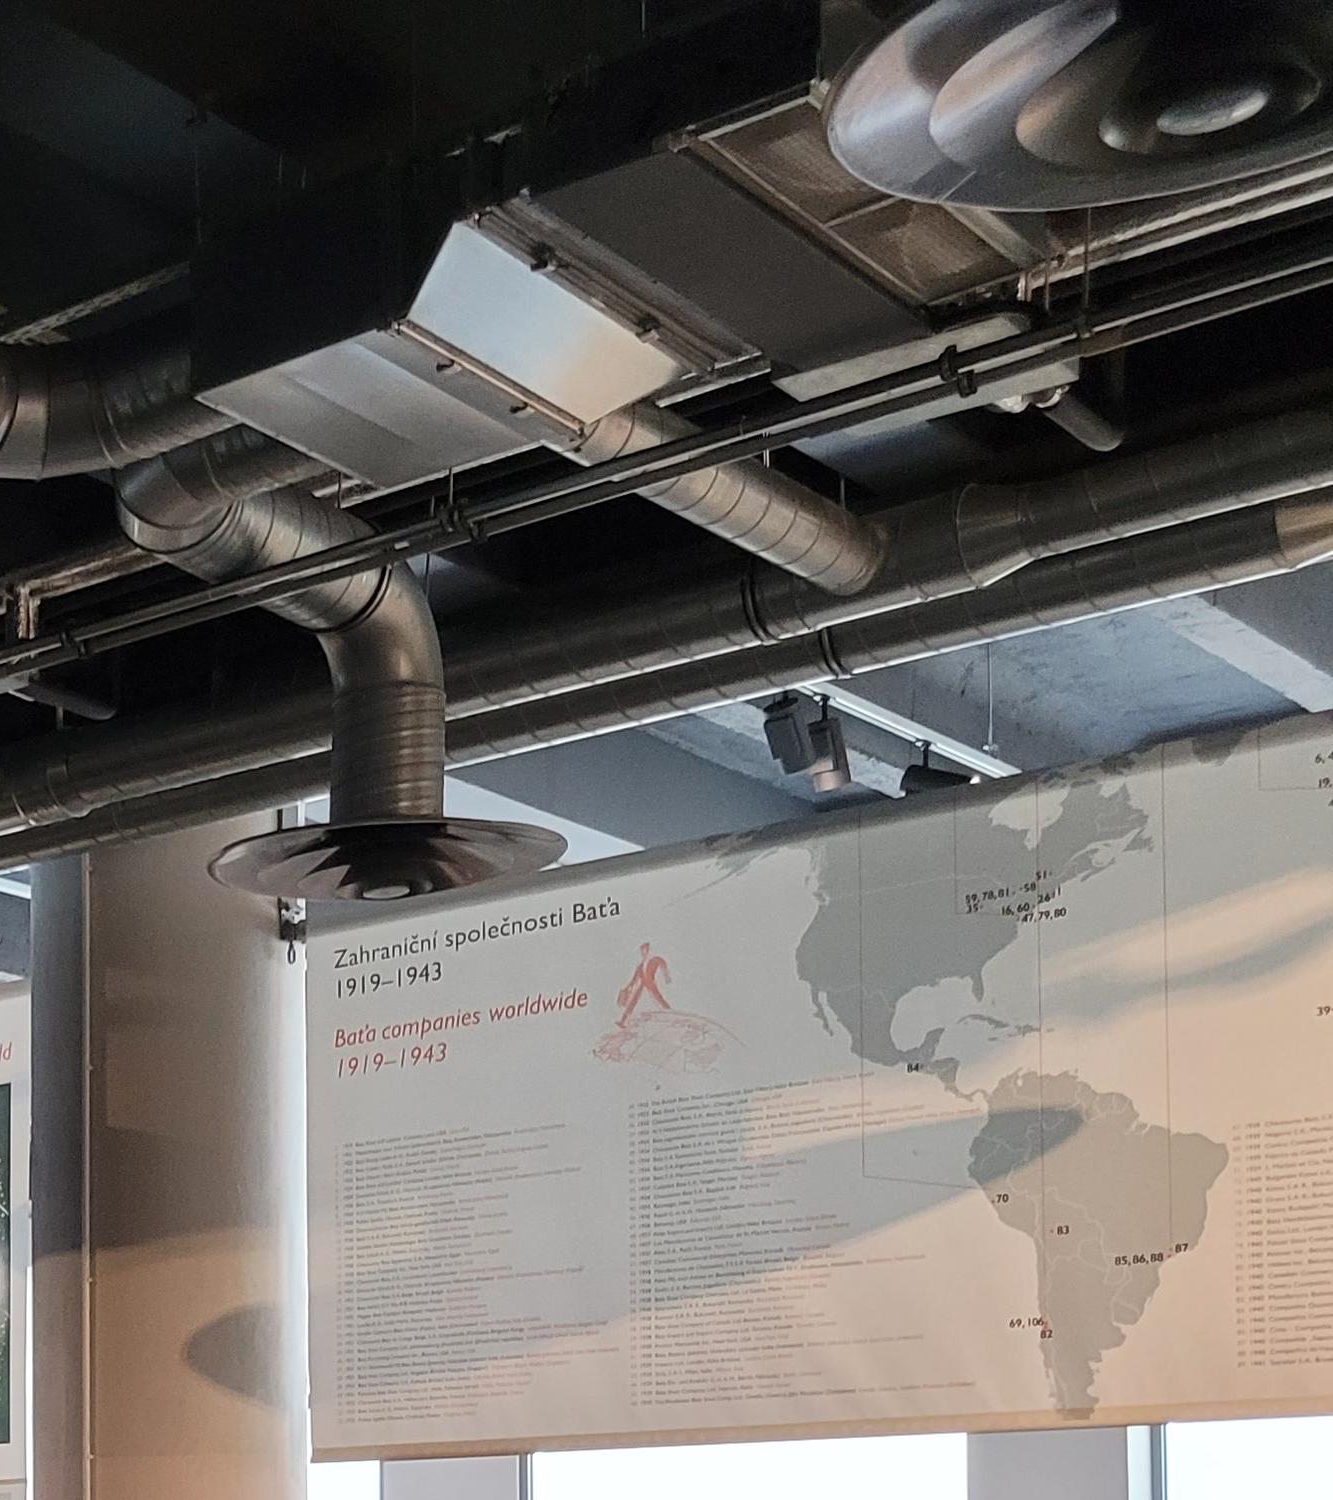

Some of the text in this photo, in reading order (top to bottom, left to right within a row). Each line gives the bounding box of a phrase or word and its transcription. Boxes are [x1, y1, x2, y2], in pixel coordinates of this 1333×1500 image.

[334, 896, 621, 969] Zahraniční společnosti Baťa
[334, 988, 588, 1048] Baťa companies worldwide
[996, 1193, 1009, 1203] 70
[1056, 1225, 1070, 1236] 83
[1174, 1243, 1189, 1253] 87
[1040, 1329, 1053, 1339] 82
